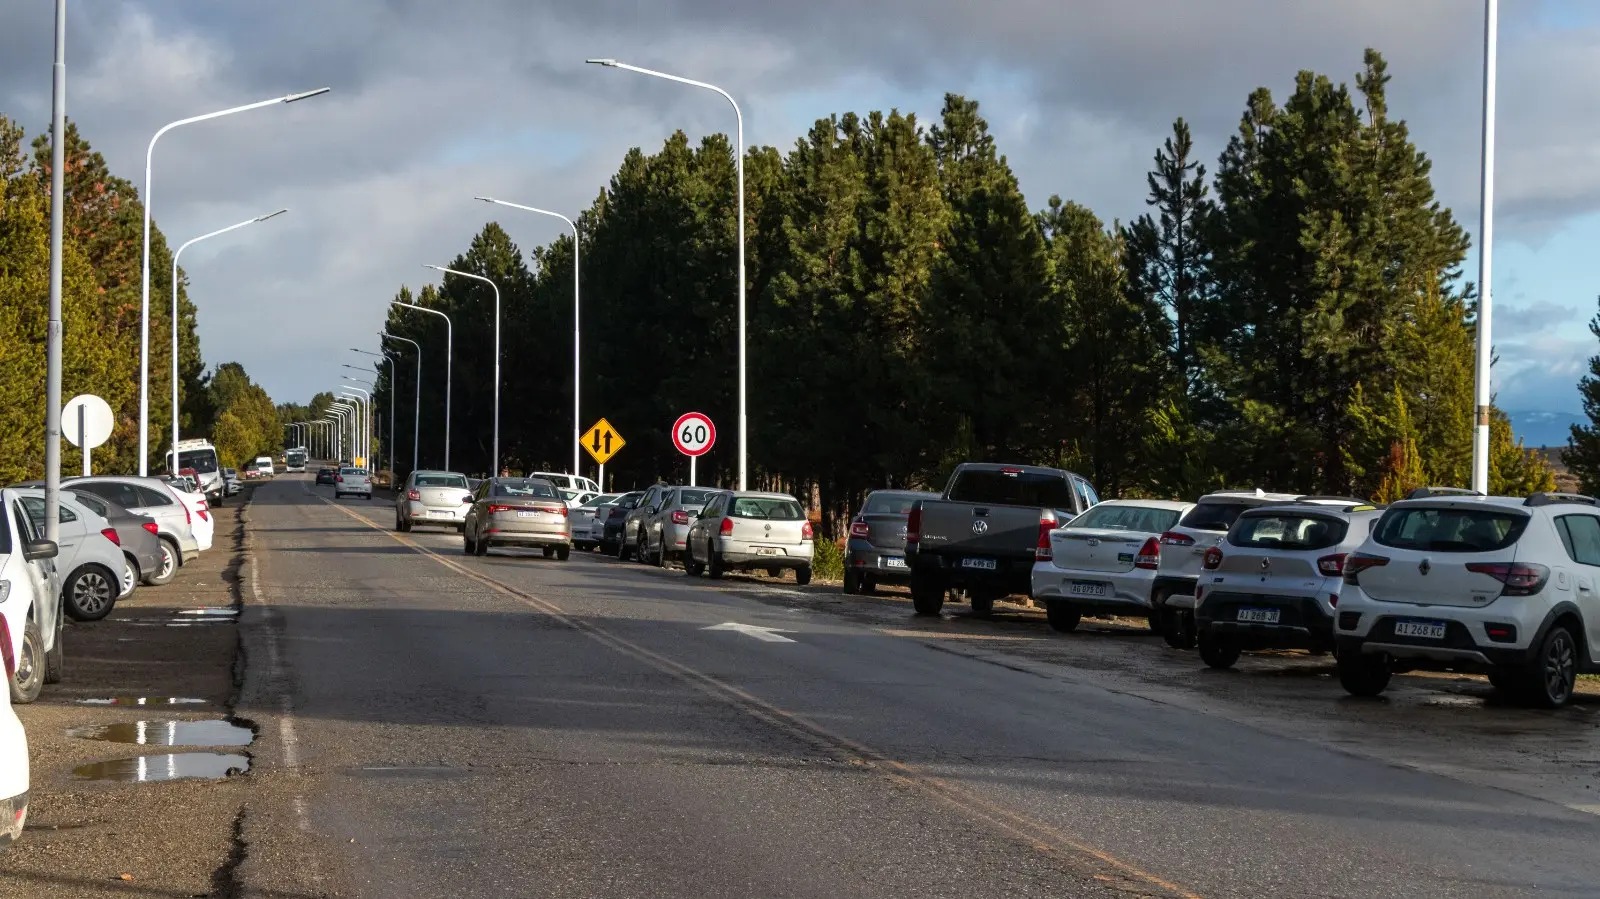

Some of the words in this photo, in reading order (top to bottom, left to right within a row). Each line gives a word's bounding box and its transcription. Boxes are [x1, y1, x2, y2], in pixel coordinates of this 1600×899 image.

[682, 425, 706, 444] 60
[1239, 610, 1249, 619] AI
[1397, 623, 1408, 634] AI
[1411, 624, 1429, 636] 268
[1430, 626, 1443, 638] KC
